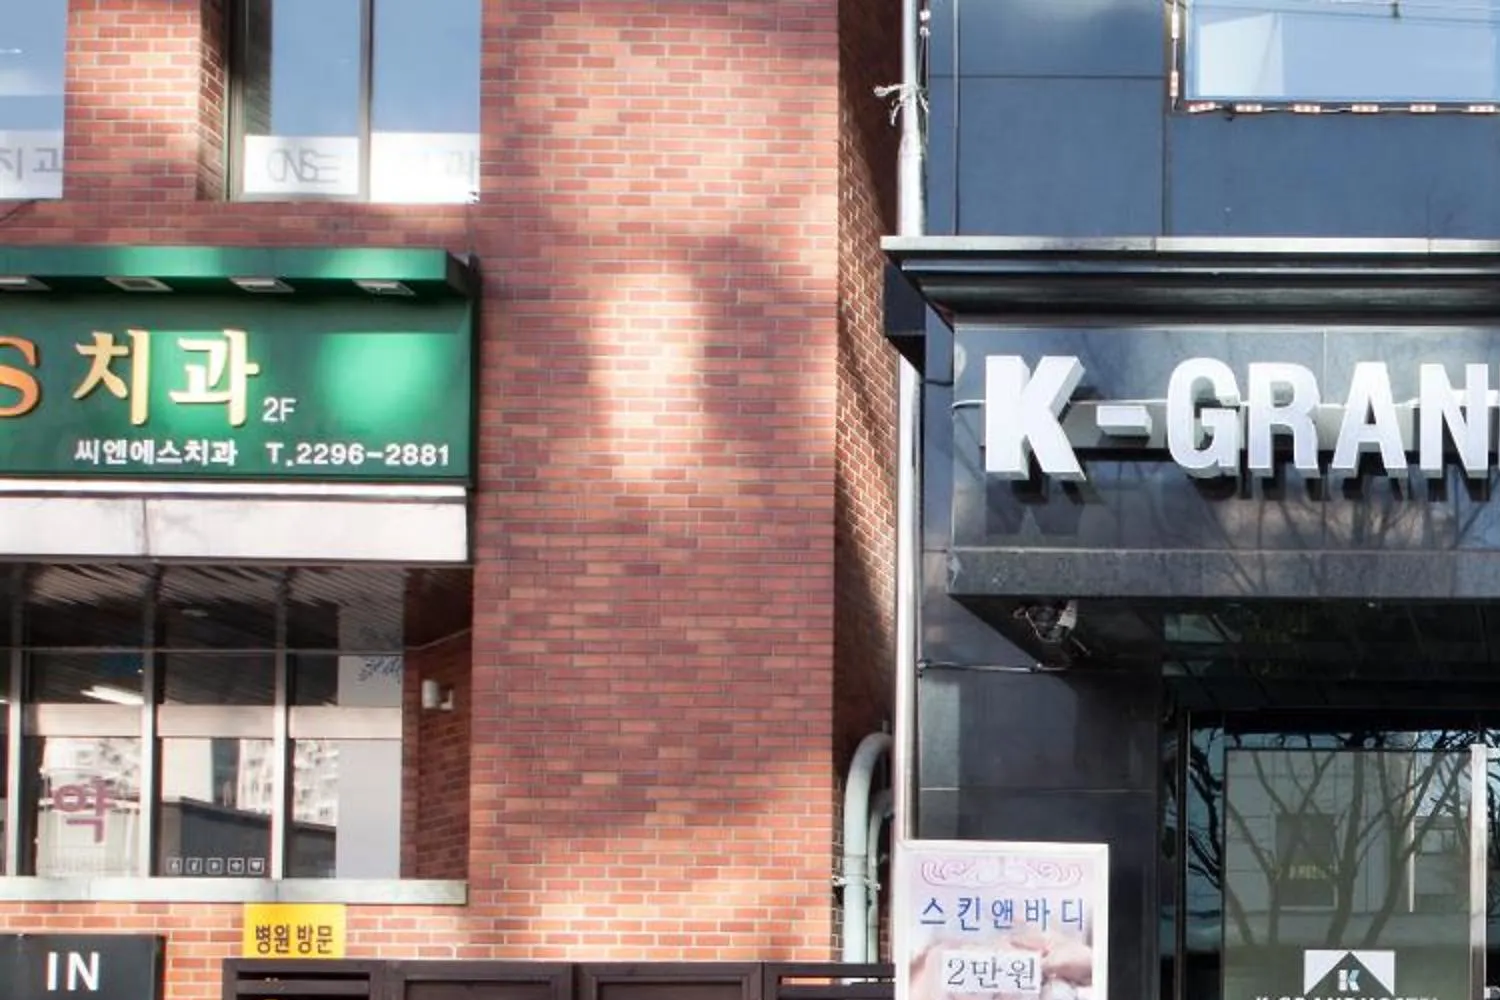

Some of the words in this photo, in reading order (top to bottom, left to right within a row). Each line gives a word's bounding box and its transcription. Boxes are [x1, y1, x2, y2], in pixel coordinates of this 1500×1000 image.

[73, 329, 261, 427] 치과
[262, 397, 297, 424] 2F
[74, 440, 239, 467] 씨엔에스치과
[266, 443, 451, 468] T.2296-2881
[921, 896, 1084, 931] 스킨앤바디
[256, 925, 290, 955] 병원
[297, 925, 332, 955] 방문
[46, 951, 100, 991] IN
[946, 956, 1037, 991] 2만원
[1338, 970, 1360, 991] K
